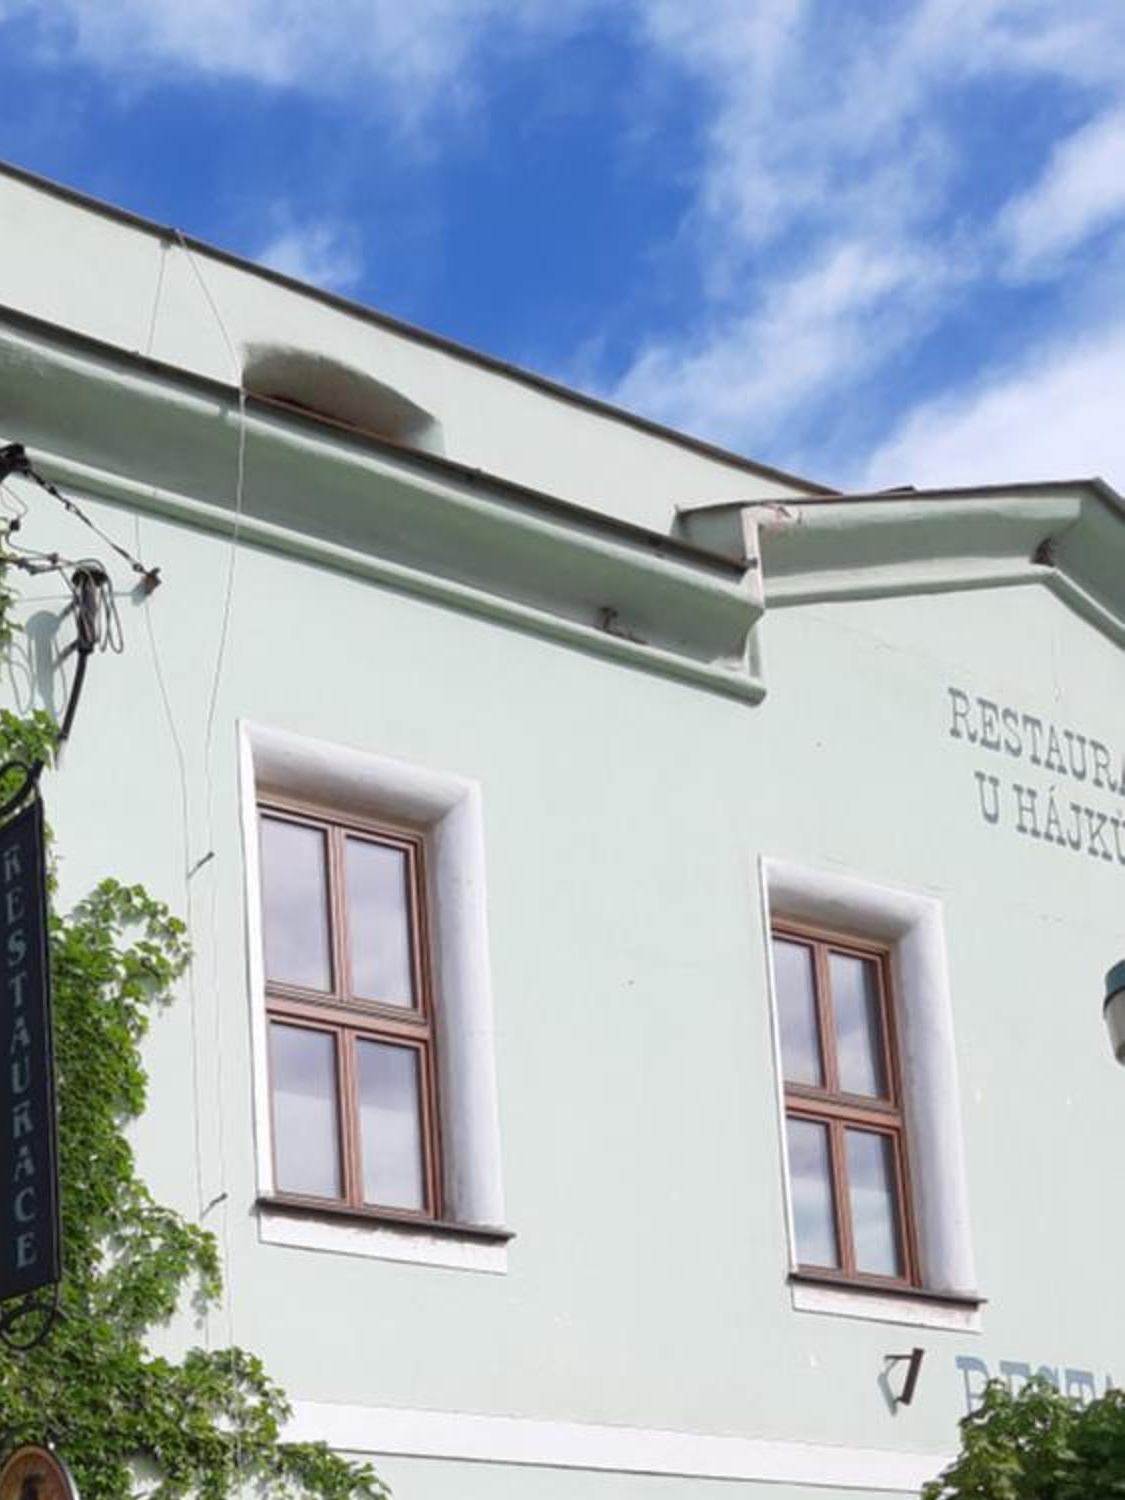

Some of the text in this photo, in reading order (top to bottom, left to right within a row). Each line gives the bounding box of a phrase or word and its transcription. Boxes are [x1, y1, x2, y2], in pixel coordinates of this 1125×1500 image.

[947, 687, 1125, 797] RESTAUR
[974, 770, 1000, 825] U
[2, 846, 38, 1270] RESTAURACE
